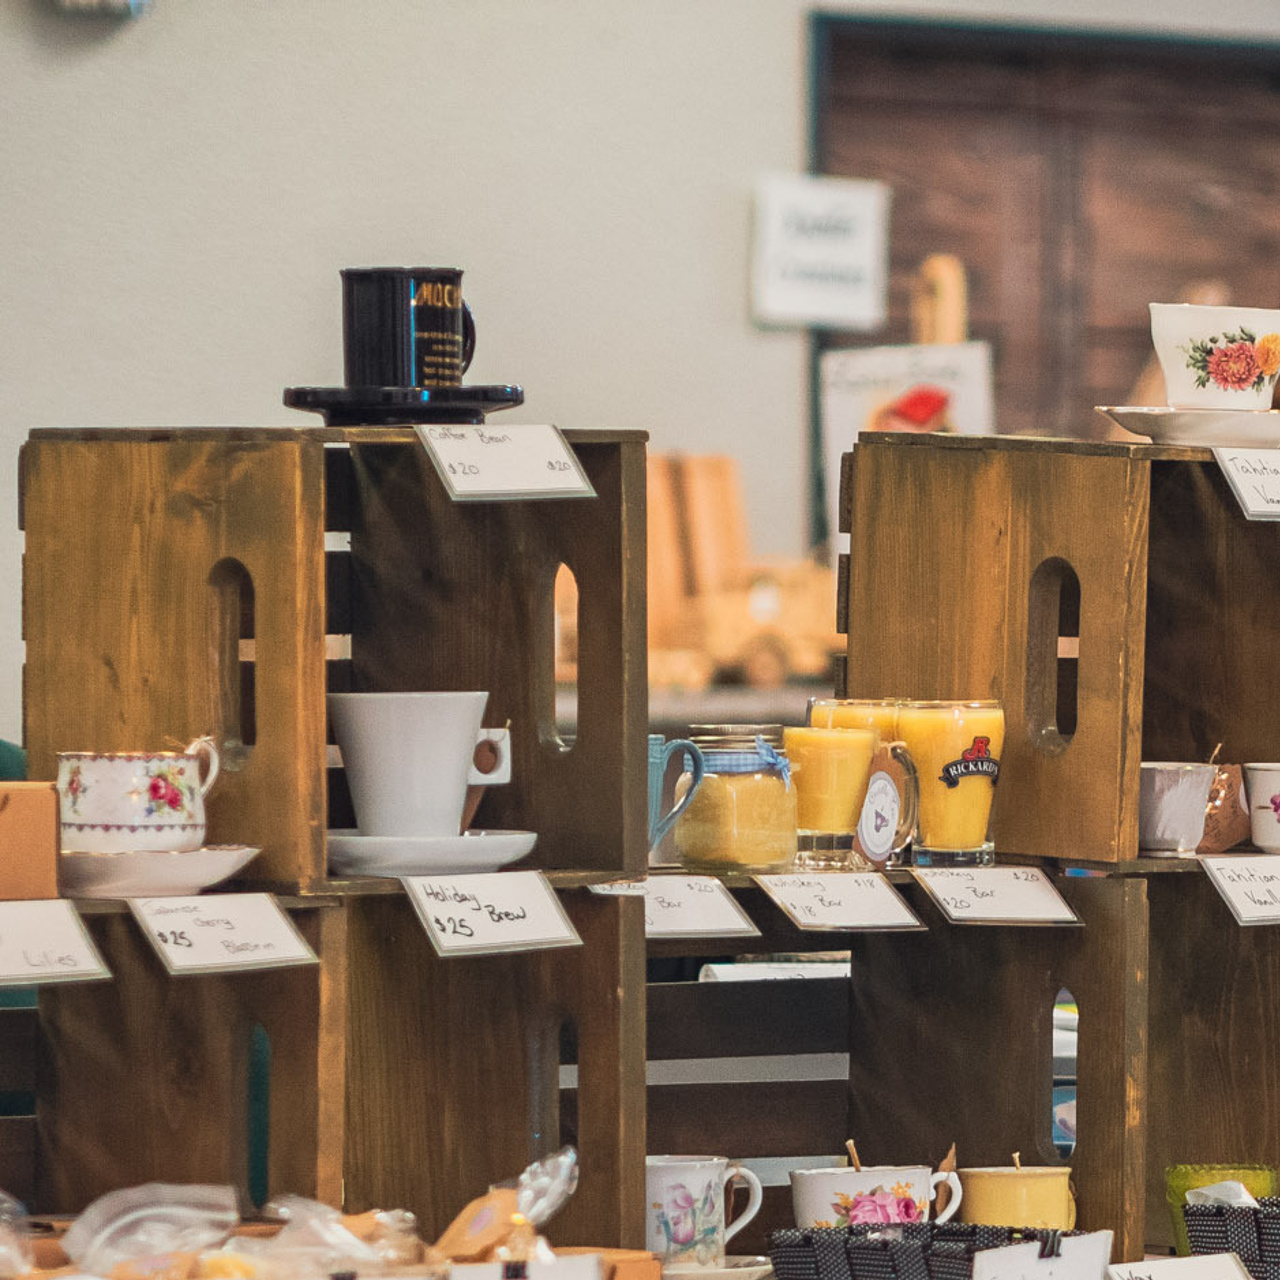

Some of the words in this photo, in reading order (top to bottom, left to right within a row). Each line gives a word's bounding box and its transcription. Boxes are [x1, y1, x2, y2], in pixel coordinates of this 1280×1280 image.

[473, 428, 512, 445] Bean
[447, 462, 480, 476] $20
[546, 460, 571, 472] $20
[1012, 872, 1040, 882] $20
[1216, 866, 1280, 884] Tahitian
[687, 882, 714, 894] $20
[854, 878, 876, 889] $18
[421, 883, 482, 911] Holiday
[964, 886, 995, 899] Bar
[654, 896, 682, 908] Bar
[813, 894, 843, 908] Bar
[942, 897, 971, 910] $20
[483, 904, 527, 923] Brew
[789, 902, 817, 917] $18
[433, 915, 475, 937] $25
[157, 930, 194, 948] $25
